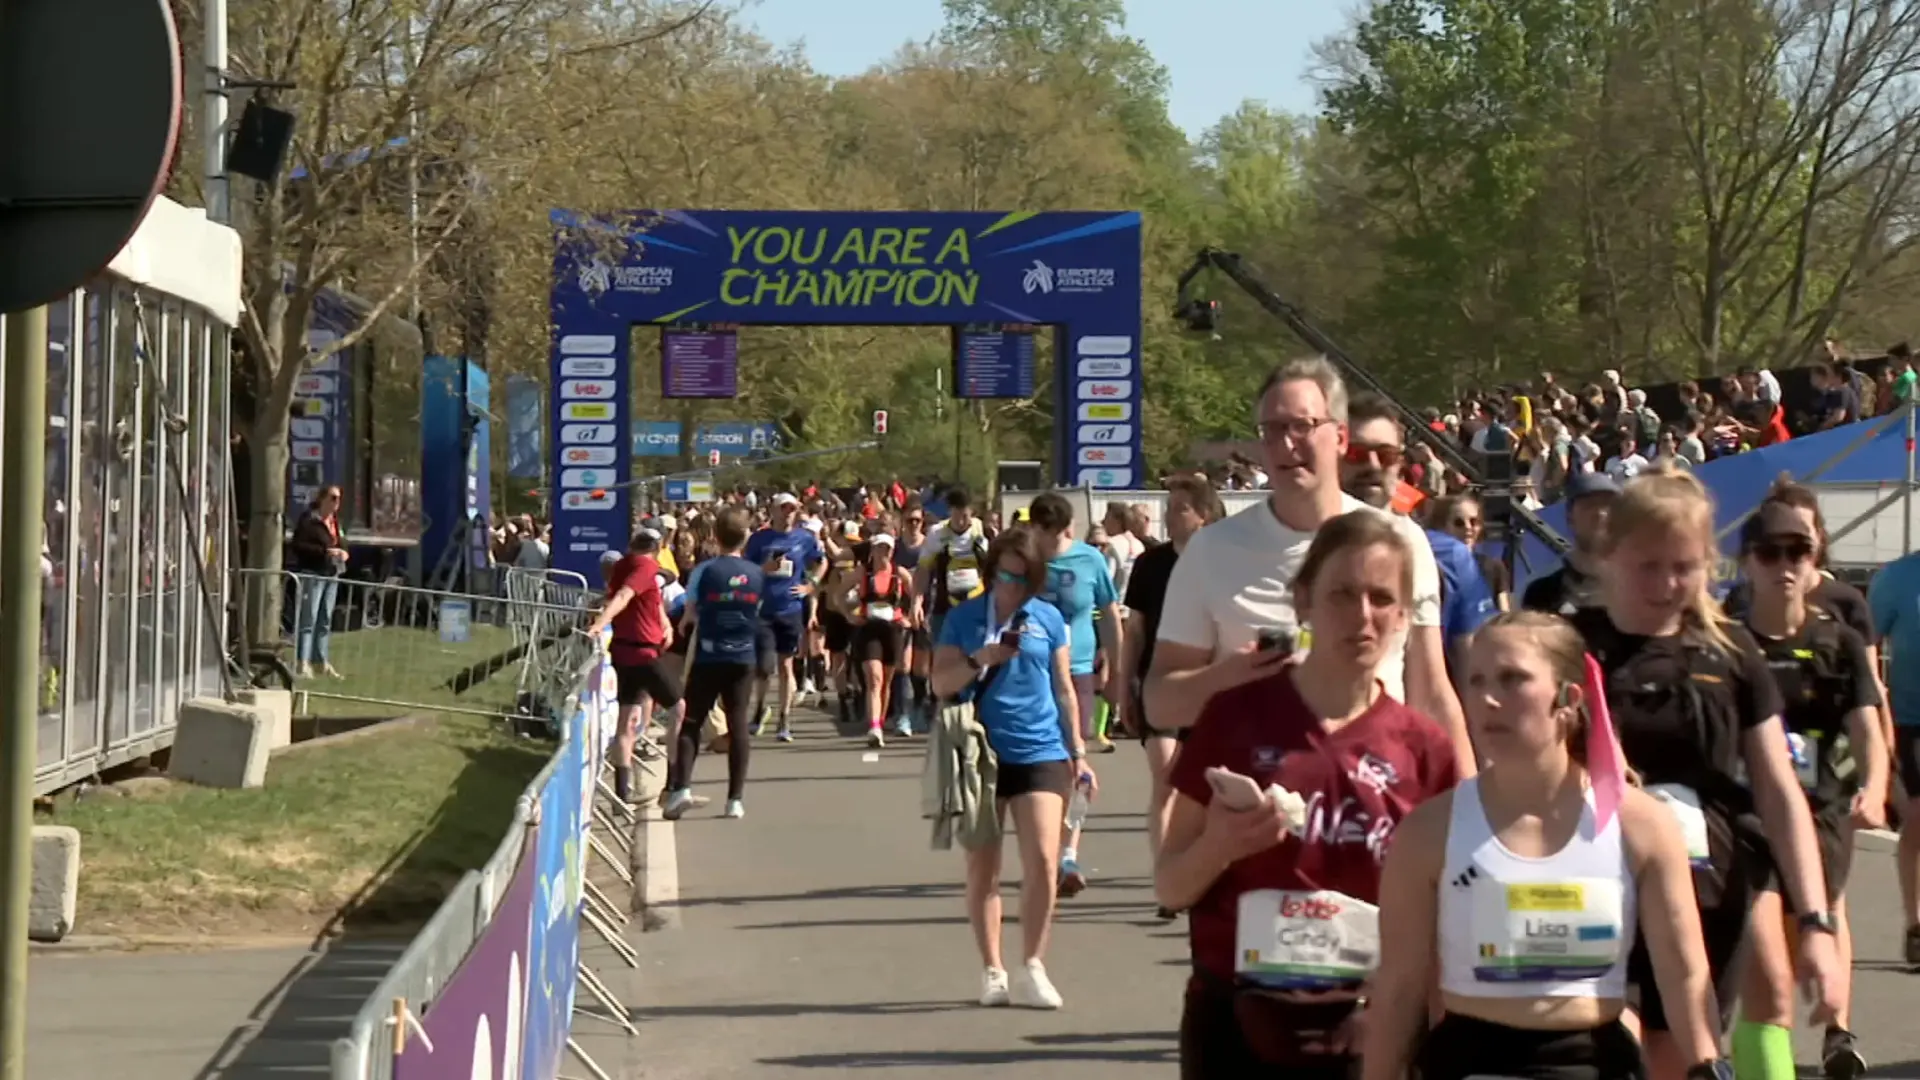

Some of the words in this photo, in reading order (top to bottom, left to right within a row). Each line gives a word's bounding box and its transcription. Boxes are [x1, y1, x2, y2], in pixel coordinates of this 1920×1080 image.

[727, 226, 828, 264] YOU
[830, 227, 932, 264] ARE
[934, 227, 970, 264] A
[614, 266, 673, 276] EUROPEAN
[1057, 268, 1114, 277] EUROPEAN
[614, 276, 673, 286] ATHLETICS
[1057, 277, 1114, 286] ATHLETICS
[719, 268, 981, 306] CHAMPION
[1525, 917, 1569, 938] Lisa
